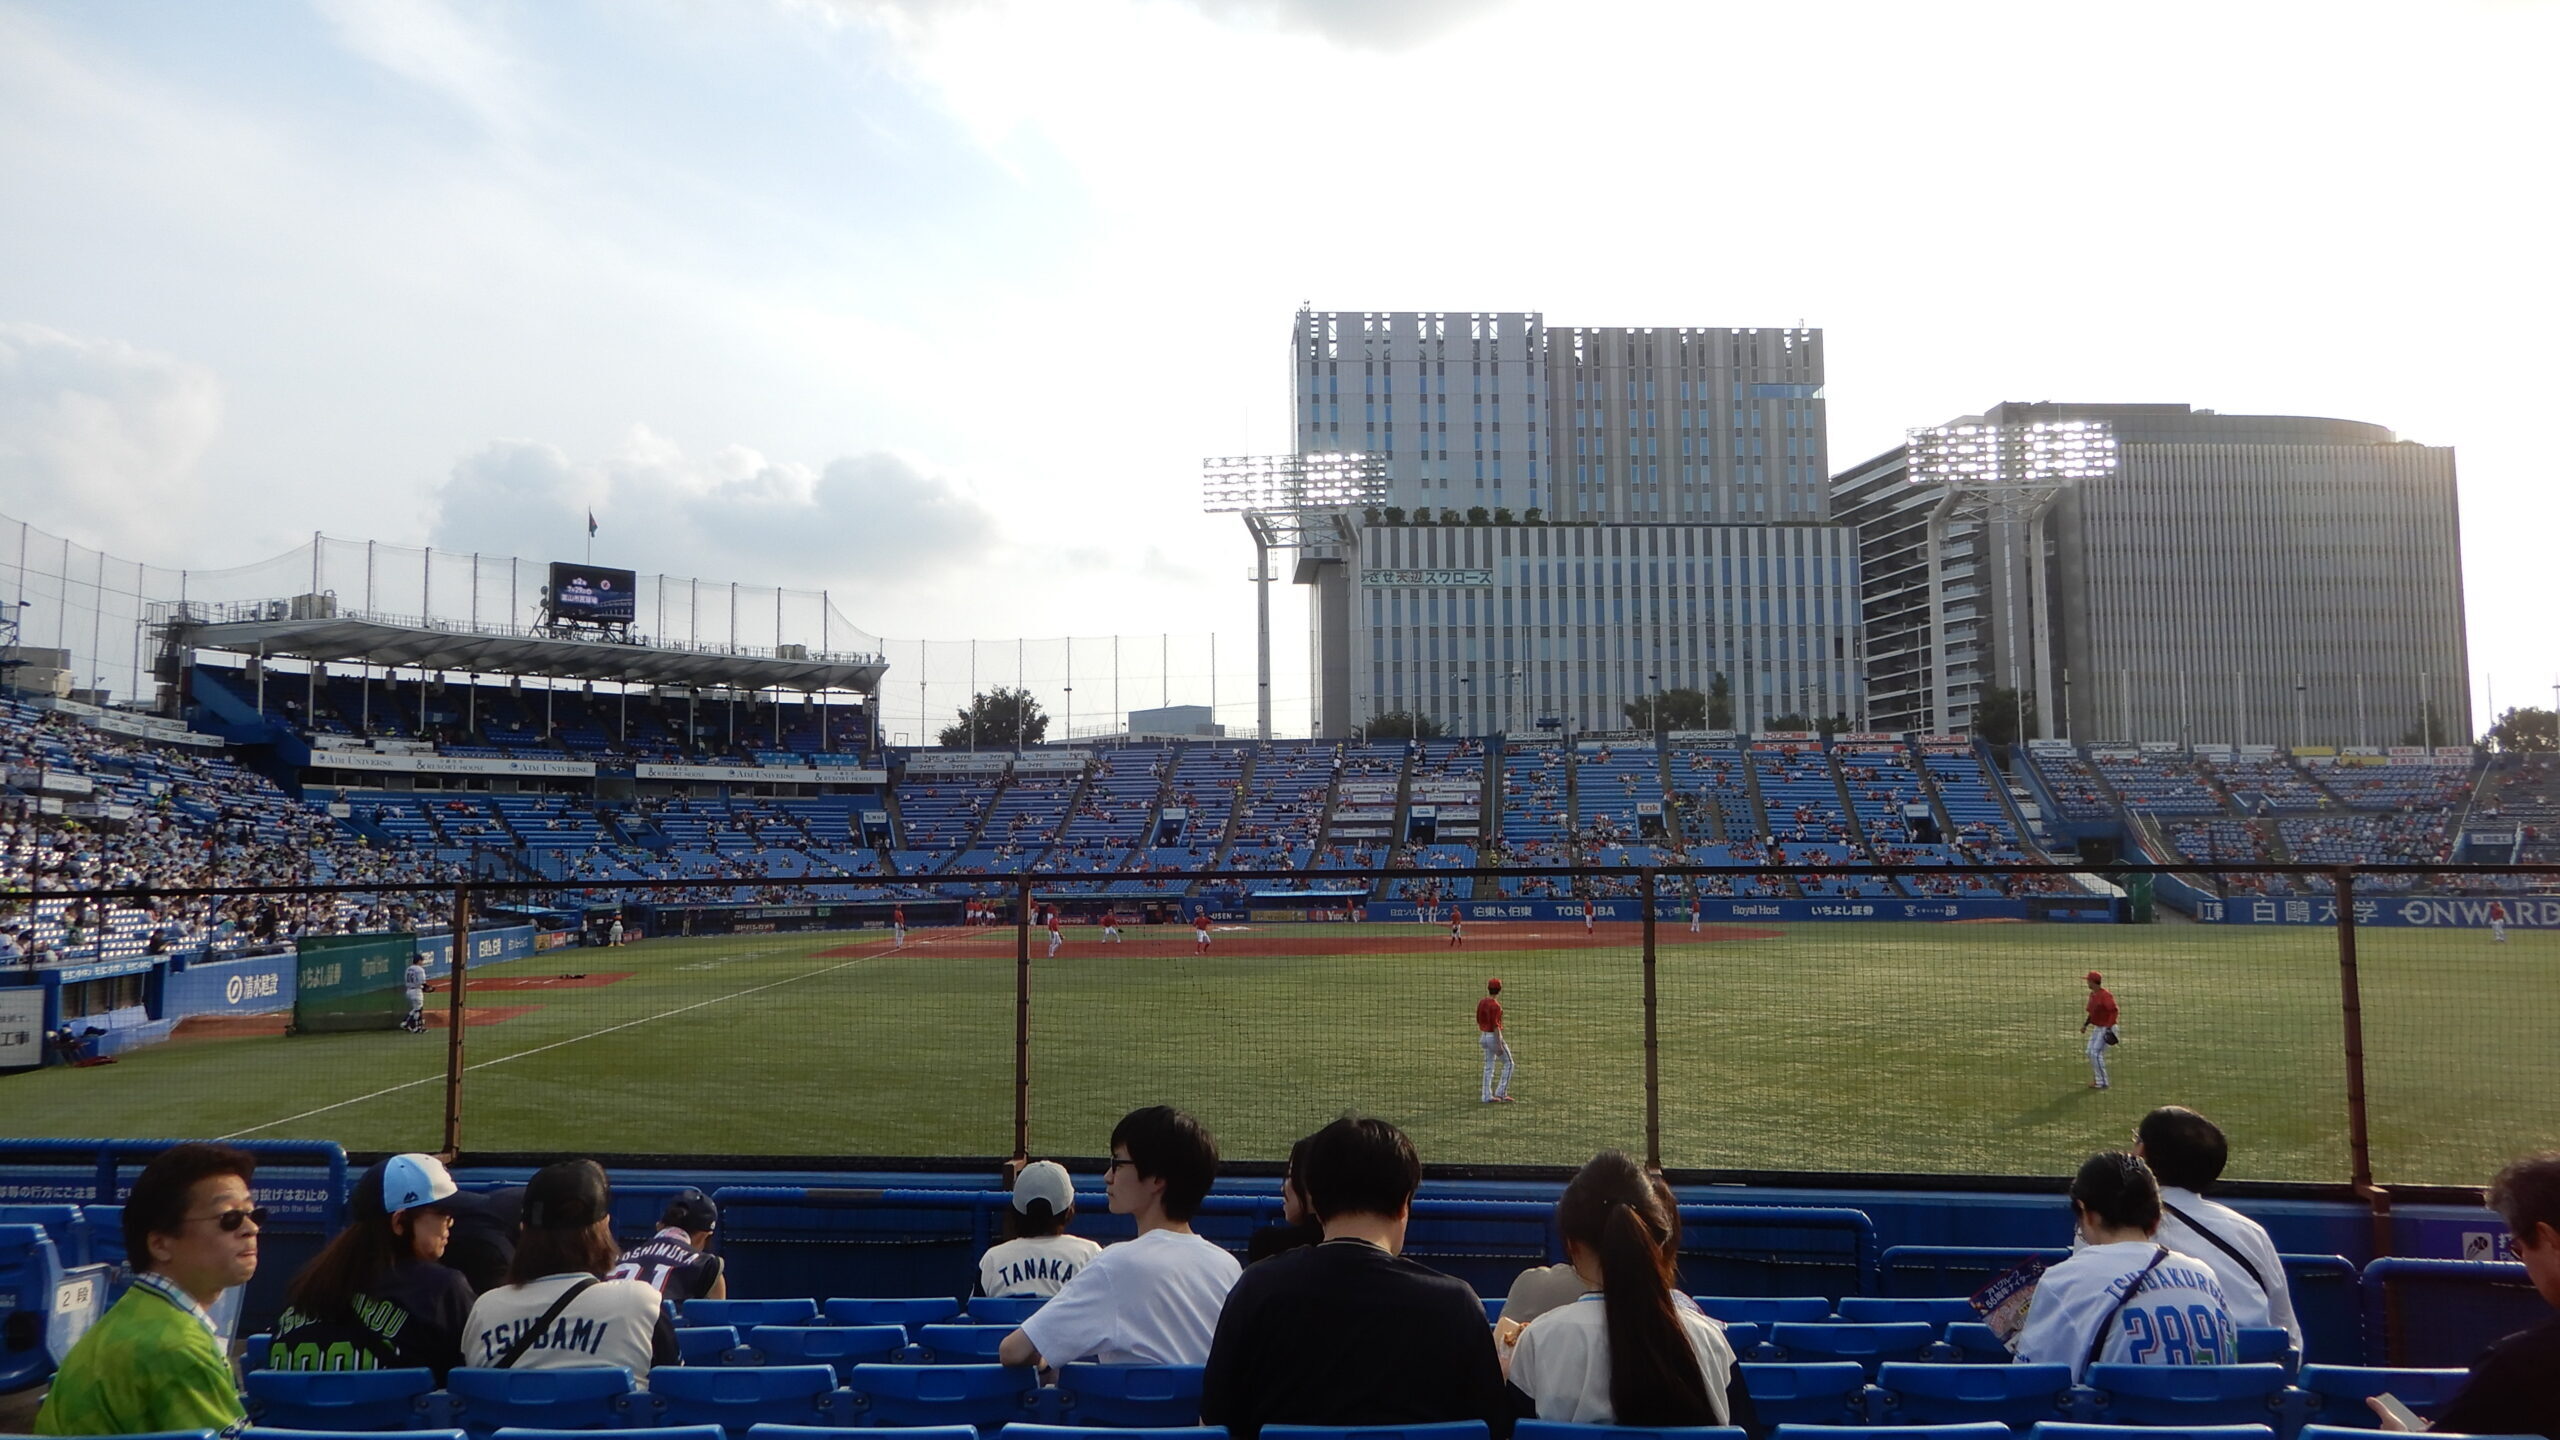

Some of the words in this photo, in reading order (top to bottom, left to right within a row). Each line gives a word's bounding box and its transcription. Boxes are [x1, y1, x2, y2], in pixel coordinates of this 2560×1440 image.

[1732, 905, 1757, 917] Royal
[1758, 905, 1780, 915] Host
[1811, 905, 1874, 916] いちよし証券
[243, 972, 279, 1000] 清水建設
[615, 1242, 699, 1266] OSHIMURA
[998, 1258, 1073, 1287] TANAKA
